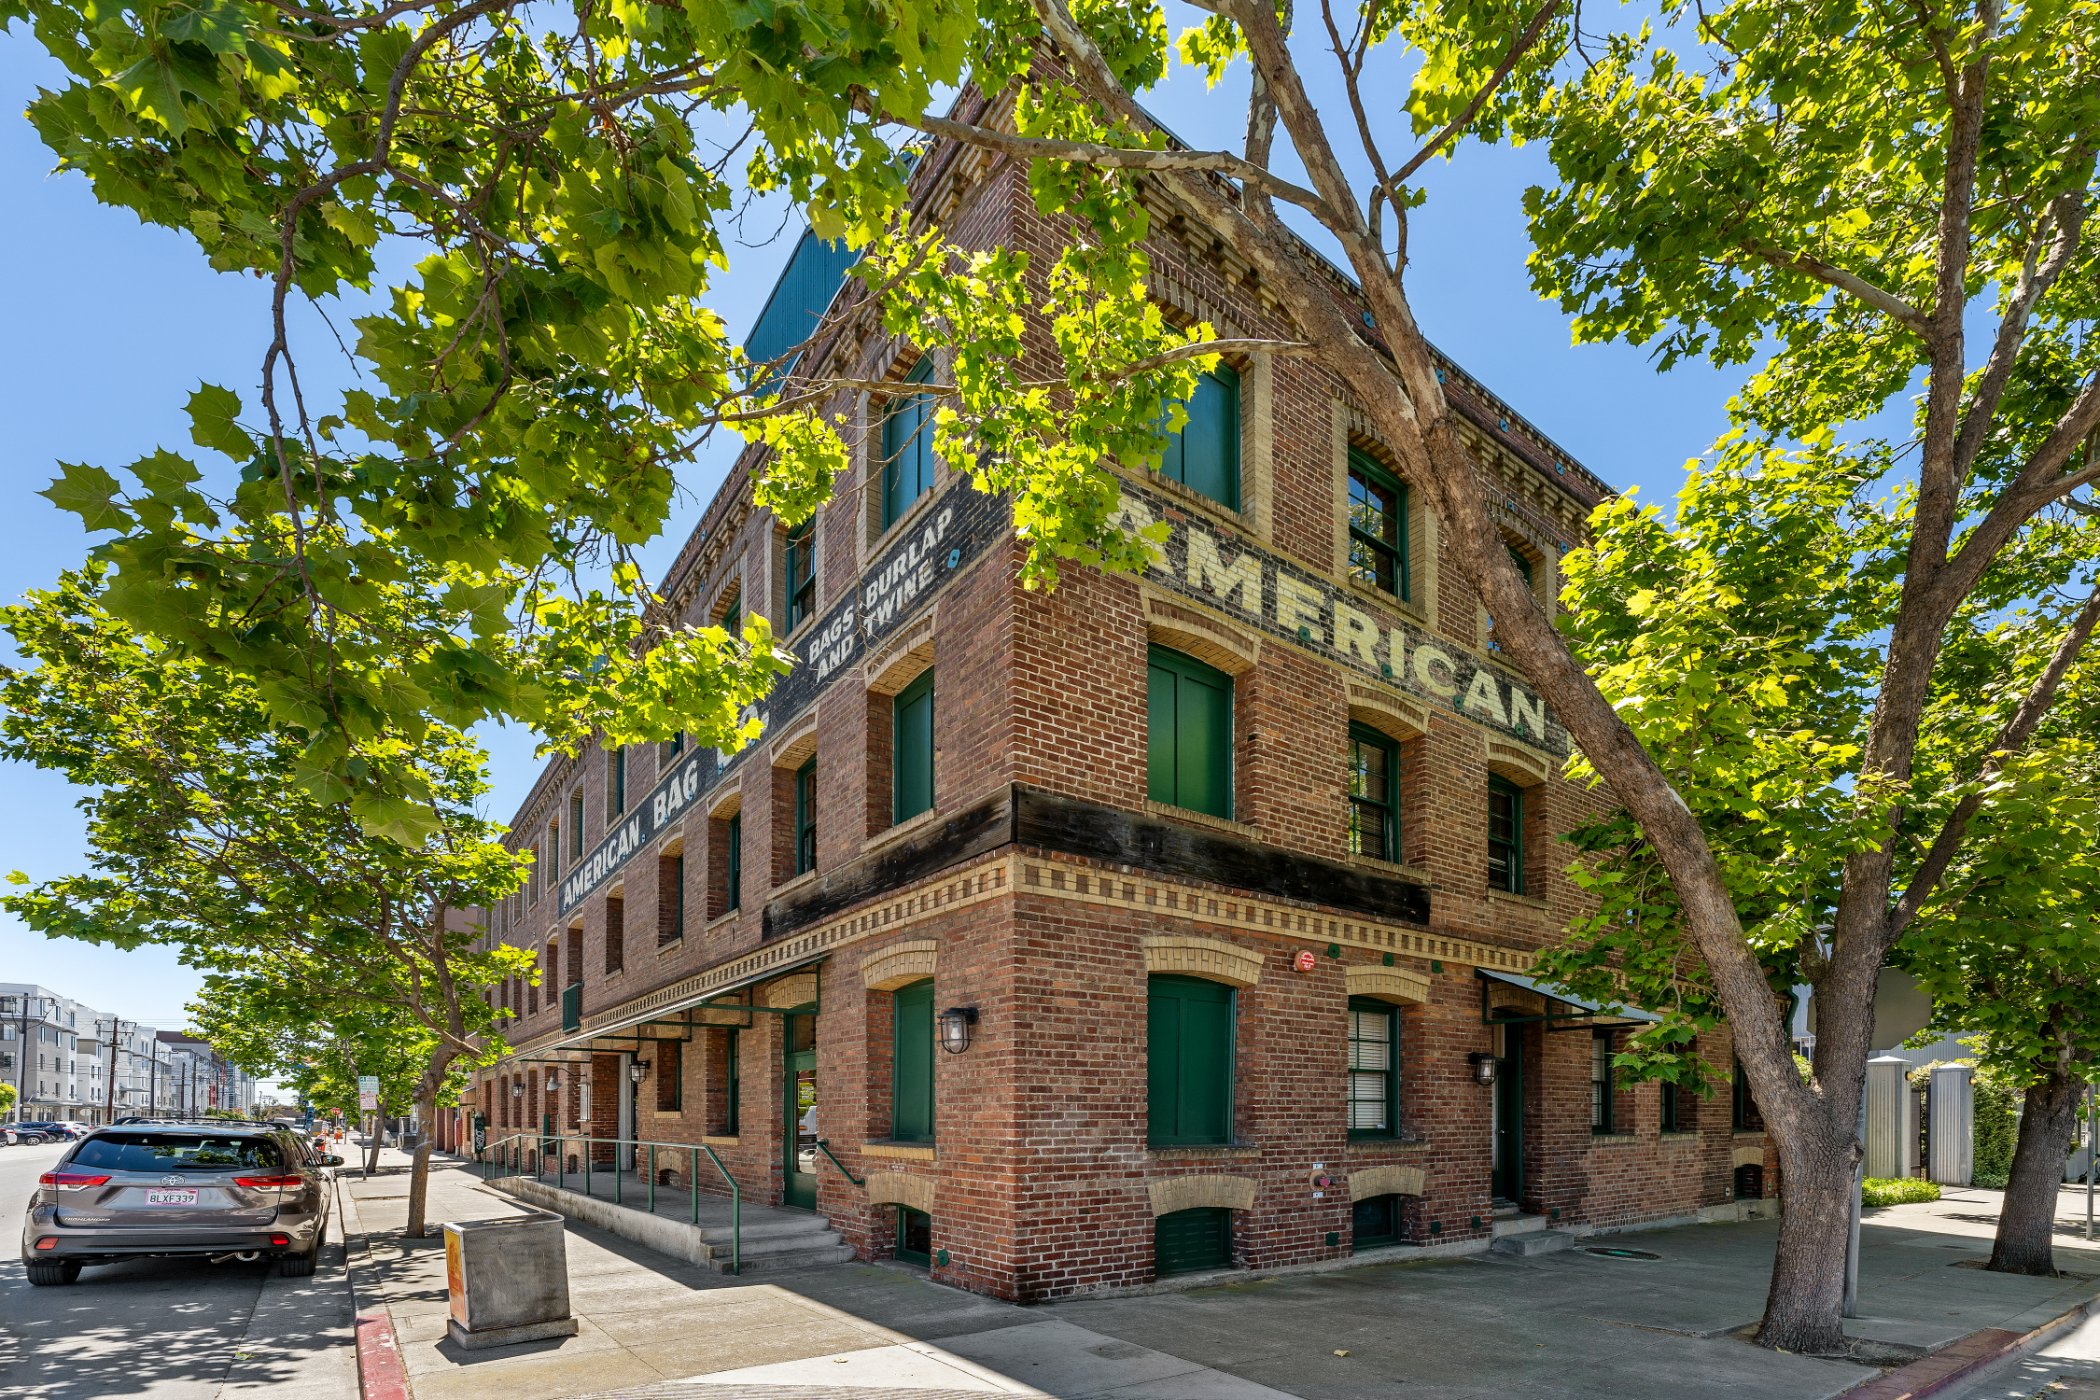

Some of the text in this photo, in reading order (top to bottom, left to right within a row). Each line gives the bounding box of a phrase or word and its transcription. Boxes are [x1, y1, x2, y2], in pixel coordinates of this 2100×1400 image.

[808, 508, 953, 665] BAGS BURLAP
[816, 557, 935, 684] AND TWINE
[1095, 495, 1545, 740] AMERICAN
[563, 814, 640, 910] AMERICAN
[653, 759, 698, 831] BAG
[150, 1194, 195, 1203] 8LXF339
